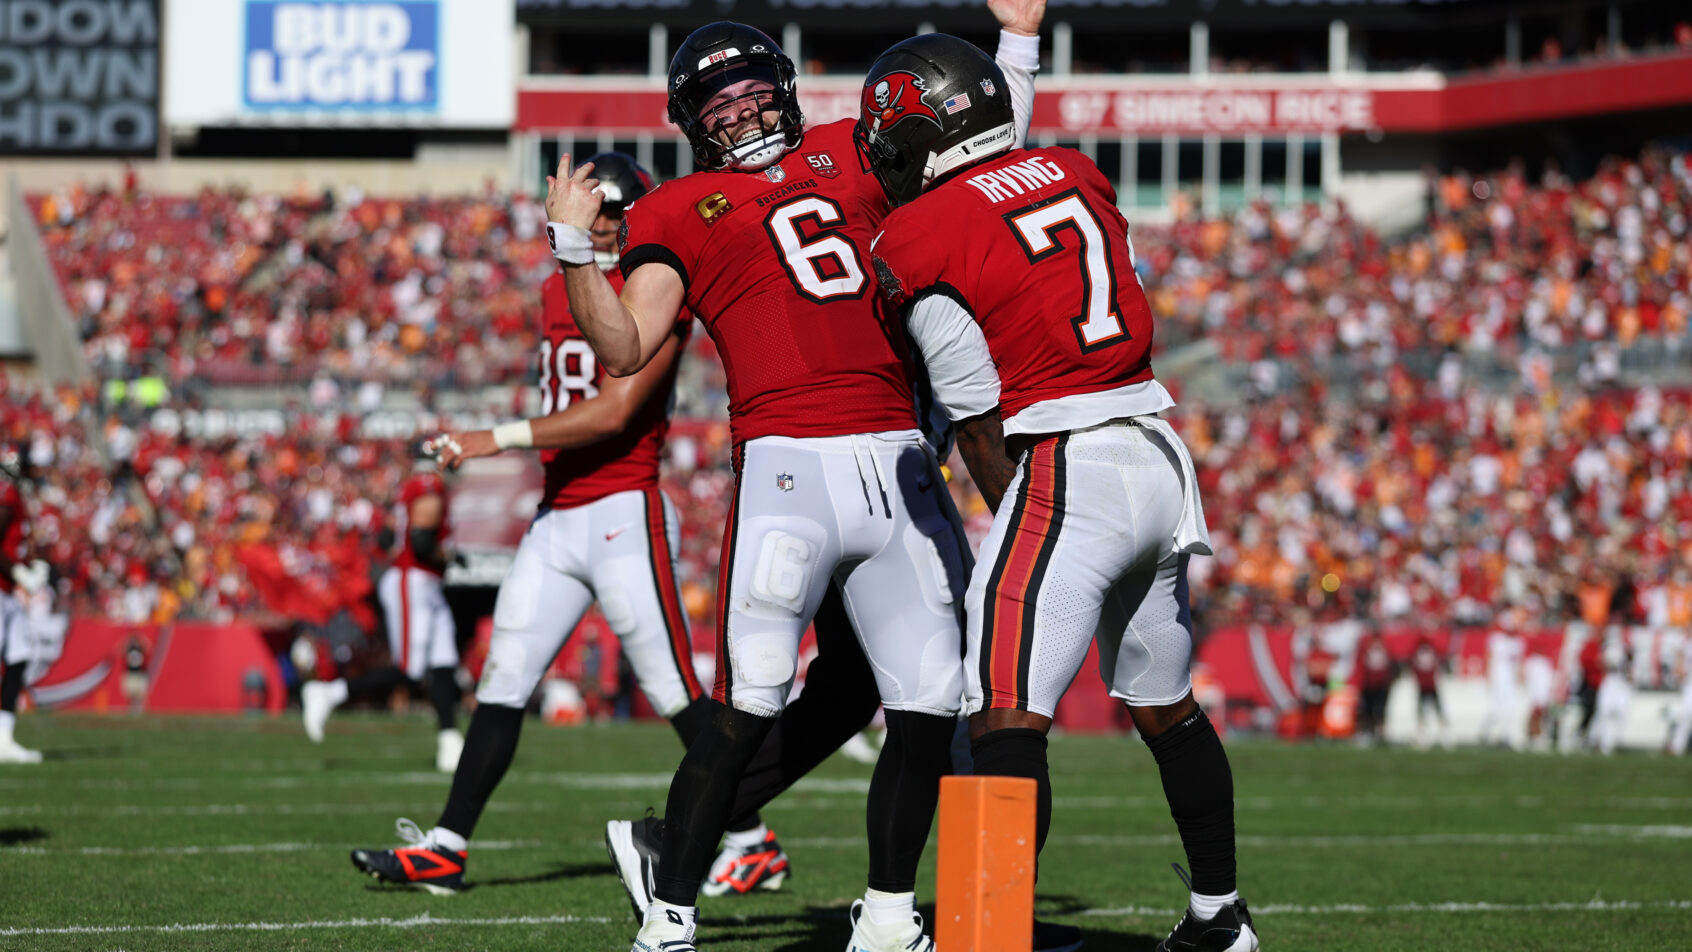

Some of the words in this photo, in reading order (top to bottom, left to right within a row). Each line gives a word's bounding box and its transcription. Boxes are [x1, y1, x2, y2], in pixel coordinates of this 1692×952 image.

[273, 3, 412, 52] BUD
[249, 50, 435, 103] LIGHT
[1275, 91, 1372, 129] RICE
[807, 154, 833, 168] 50
[973, 136, 996, 147] CHOOSE
[966, 156, 1066, 203] IRVING
[763, 193, 870, 305] 6
[1002, 186, 1132, 355] 7
[757, 531, 809, 601] 6
